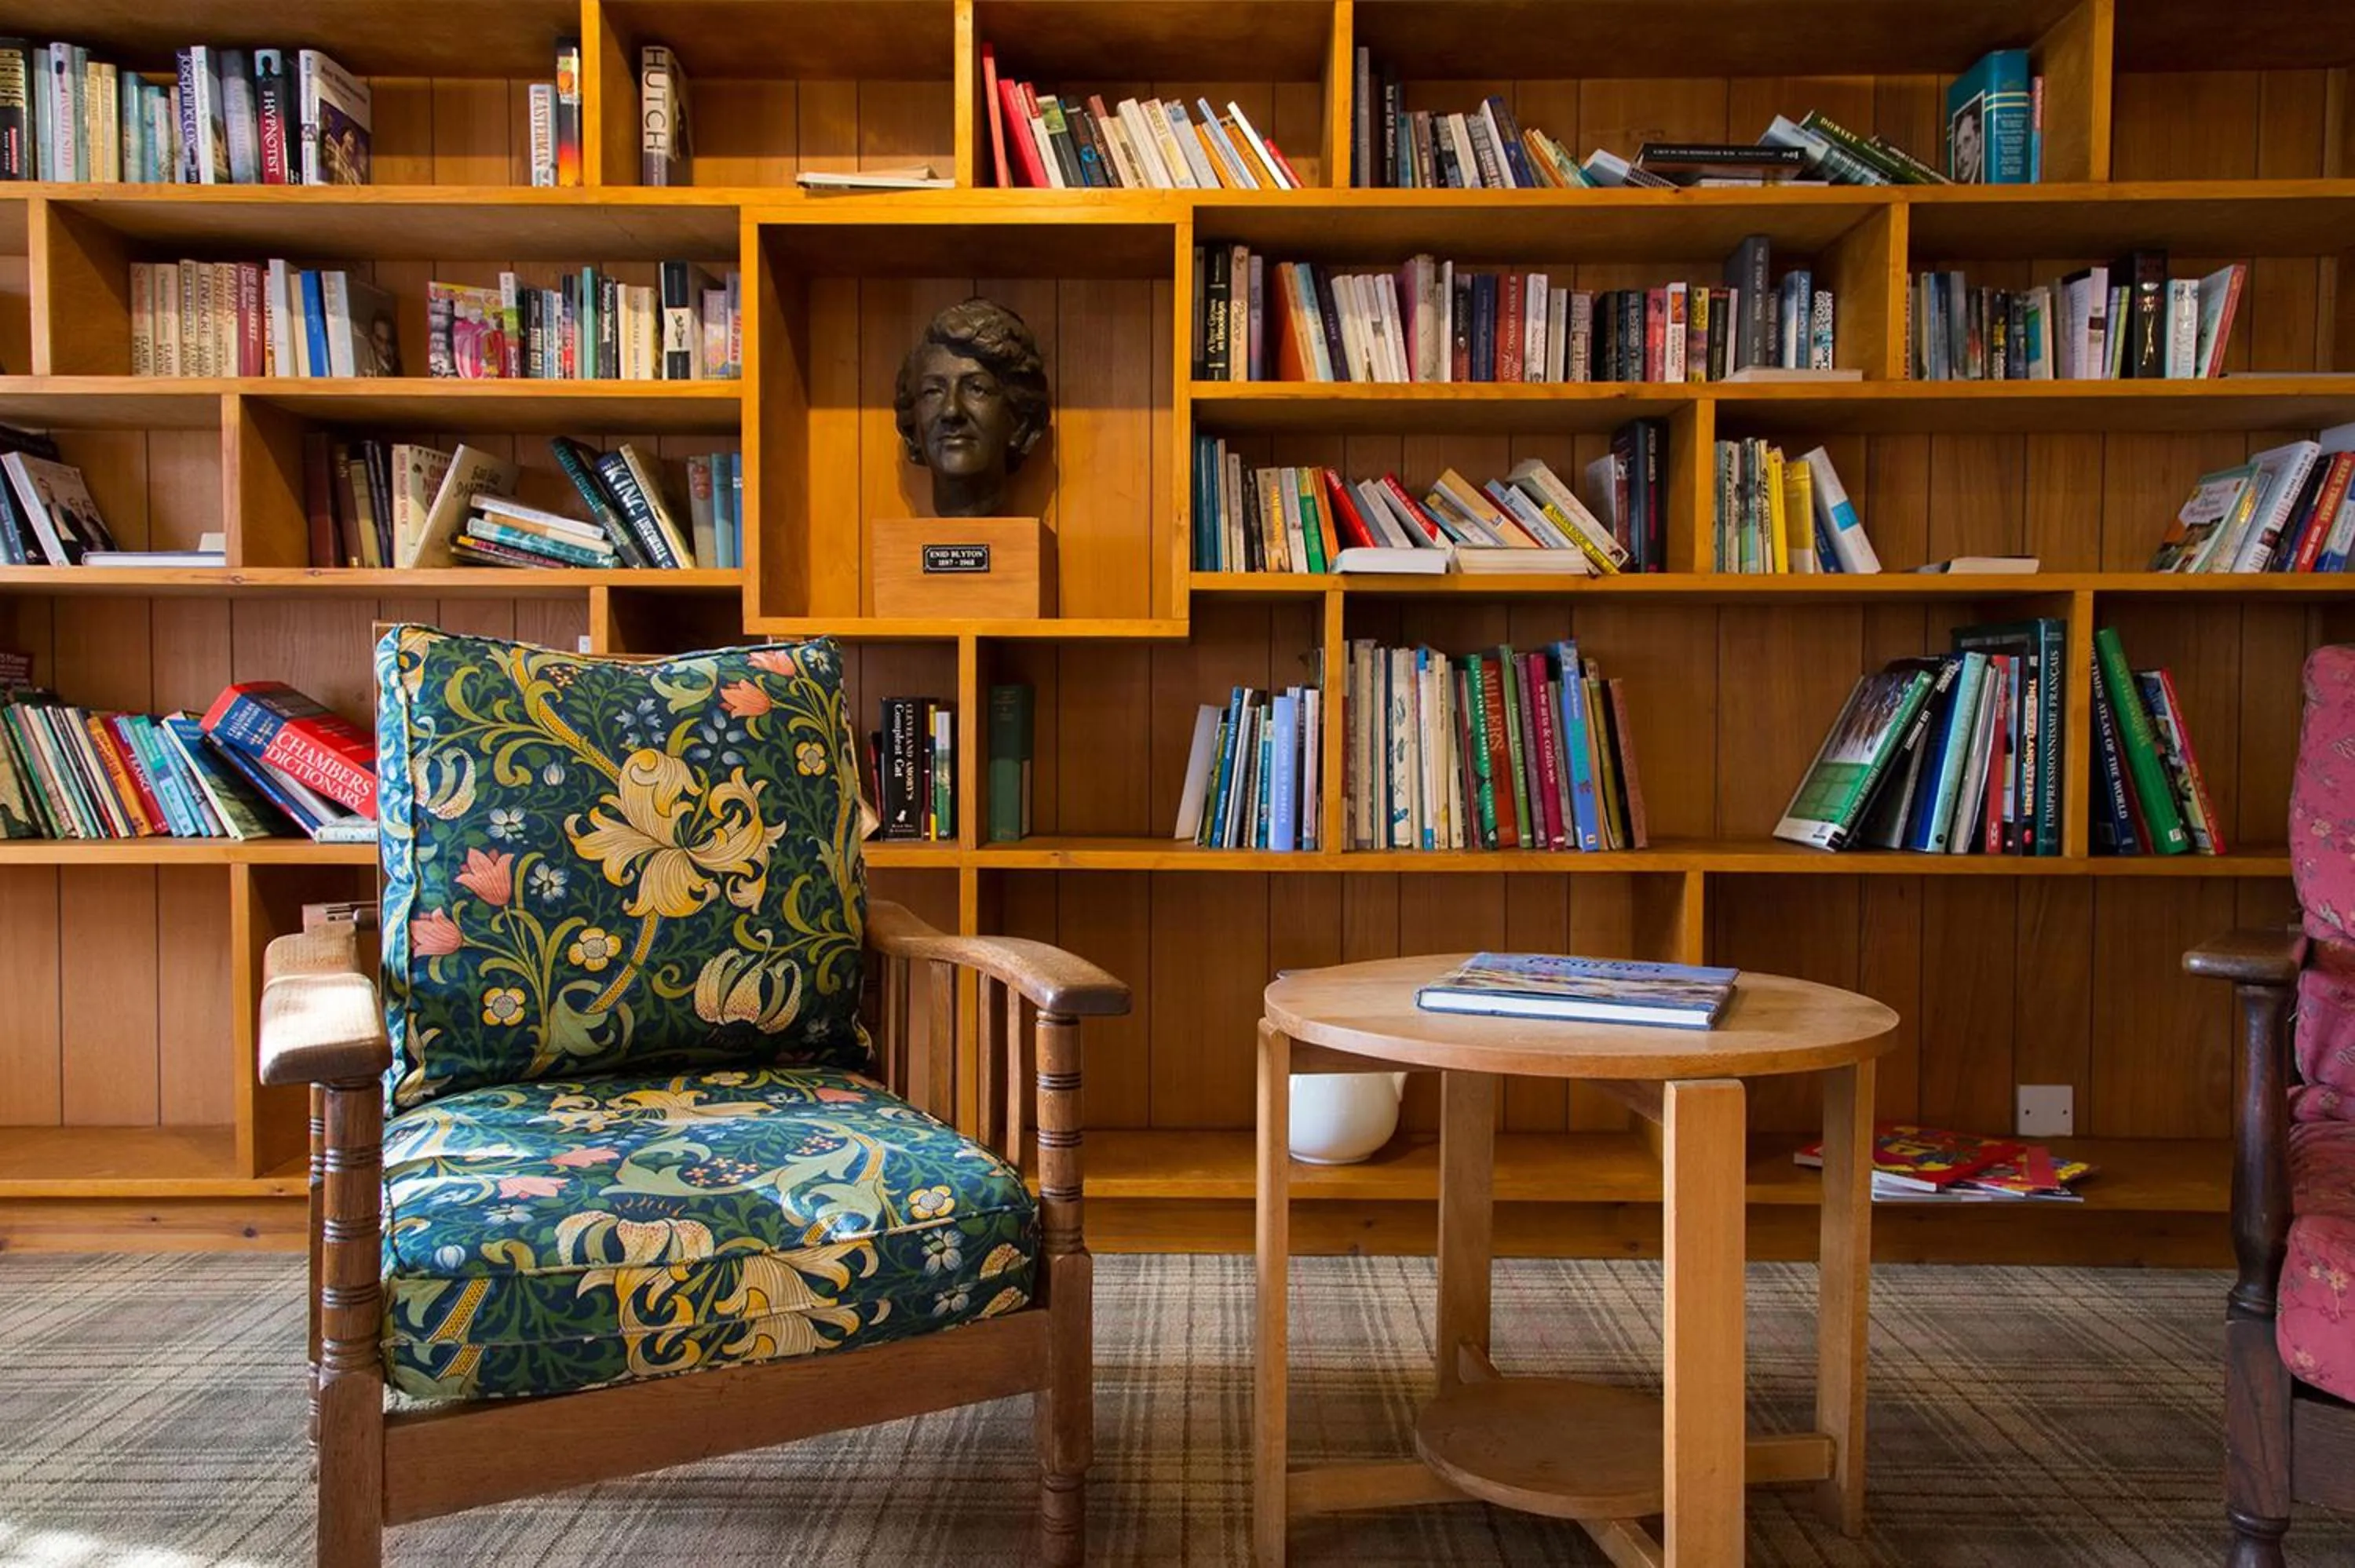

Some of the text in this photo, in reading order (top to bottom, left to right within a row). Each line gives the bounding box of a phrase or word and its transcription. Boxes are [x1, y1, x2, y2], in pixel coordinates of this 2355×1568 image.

[178, 53, 195, 119] Josephine
[644, 49, 666, 152] HUTCH
[263, 99, 279, 175] HYPNOTIST
[1820, 116, 1859, 143] DORSET
[606, 461, 644, 516] KING
[1483, 669, 1504, 751] MILLERS
[1543, 727, 1551, 738] &
[2098, 702, 2111, 735] ATLAS
[275, 730, 375, 796] CHAMBERS
[892, 704, 904, 777] Compleat Cat
[905, 703, 914, 800] CLEVELAND AMORY'S
[1544, 738, 1554, 768] crafts
[2106, 738, 2115, 752] OF
[2109, 756, 2118, 777] THE
[127, 752, 151, 793] FRANCE
[266, 746, 366, 809] DICTIONARY
[2114, 779, 2128, 819] WORLD
